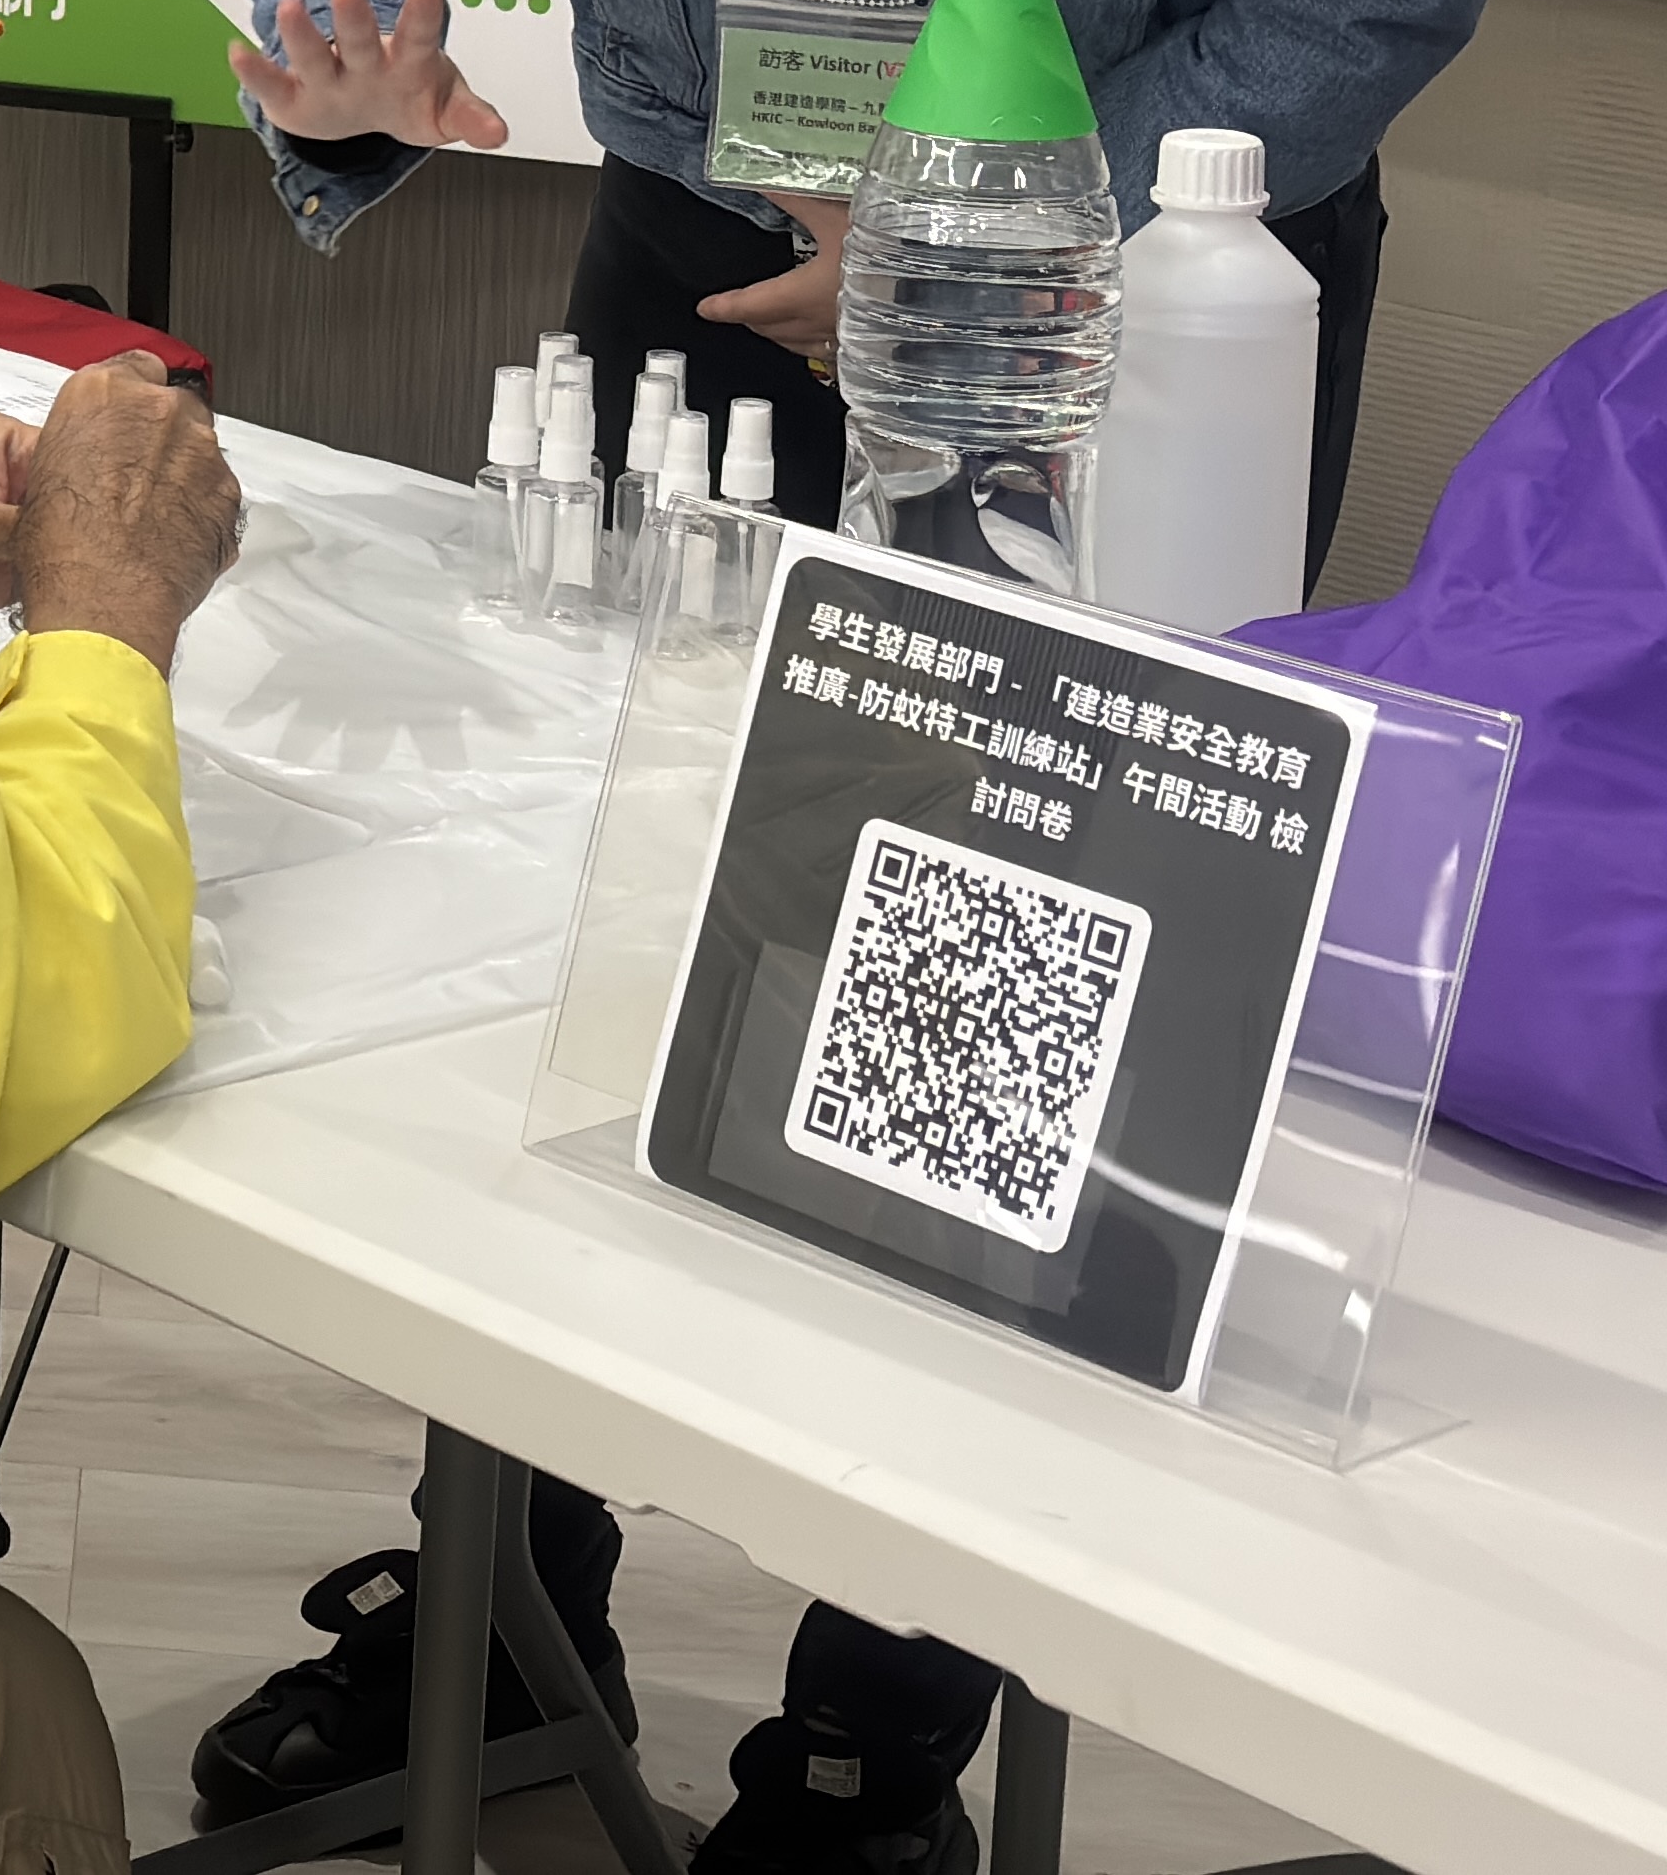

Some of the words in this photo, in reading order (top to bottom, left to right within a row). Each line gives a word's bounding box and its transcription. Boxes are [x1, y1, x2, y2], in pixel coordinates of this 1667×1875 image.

[759, 47, 804, 72] 訪客
[810, 54, 871, 75] Visitor
[751, 111, 783, 125] HKIC
[797, 115, 855, 134] Kowloon
[858, 121, 876, 134] Ba
[753, 90, 846, 114] 香港建造學院
[860, 101, 886, 117] 九
[807, 601, 1004, 696] 學生發展部門
[1052, 674, 1312, 790] 「建造業安全教育
[782, 653, 1103, 792] 推廣-防蚊特工訓練站」
[1122, 760, 1263, 842] 午間活動
[1269, 807, 1310, 856] 檢
[970, 775, 1074, 843] 討問卷
